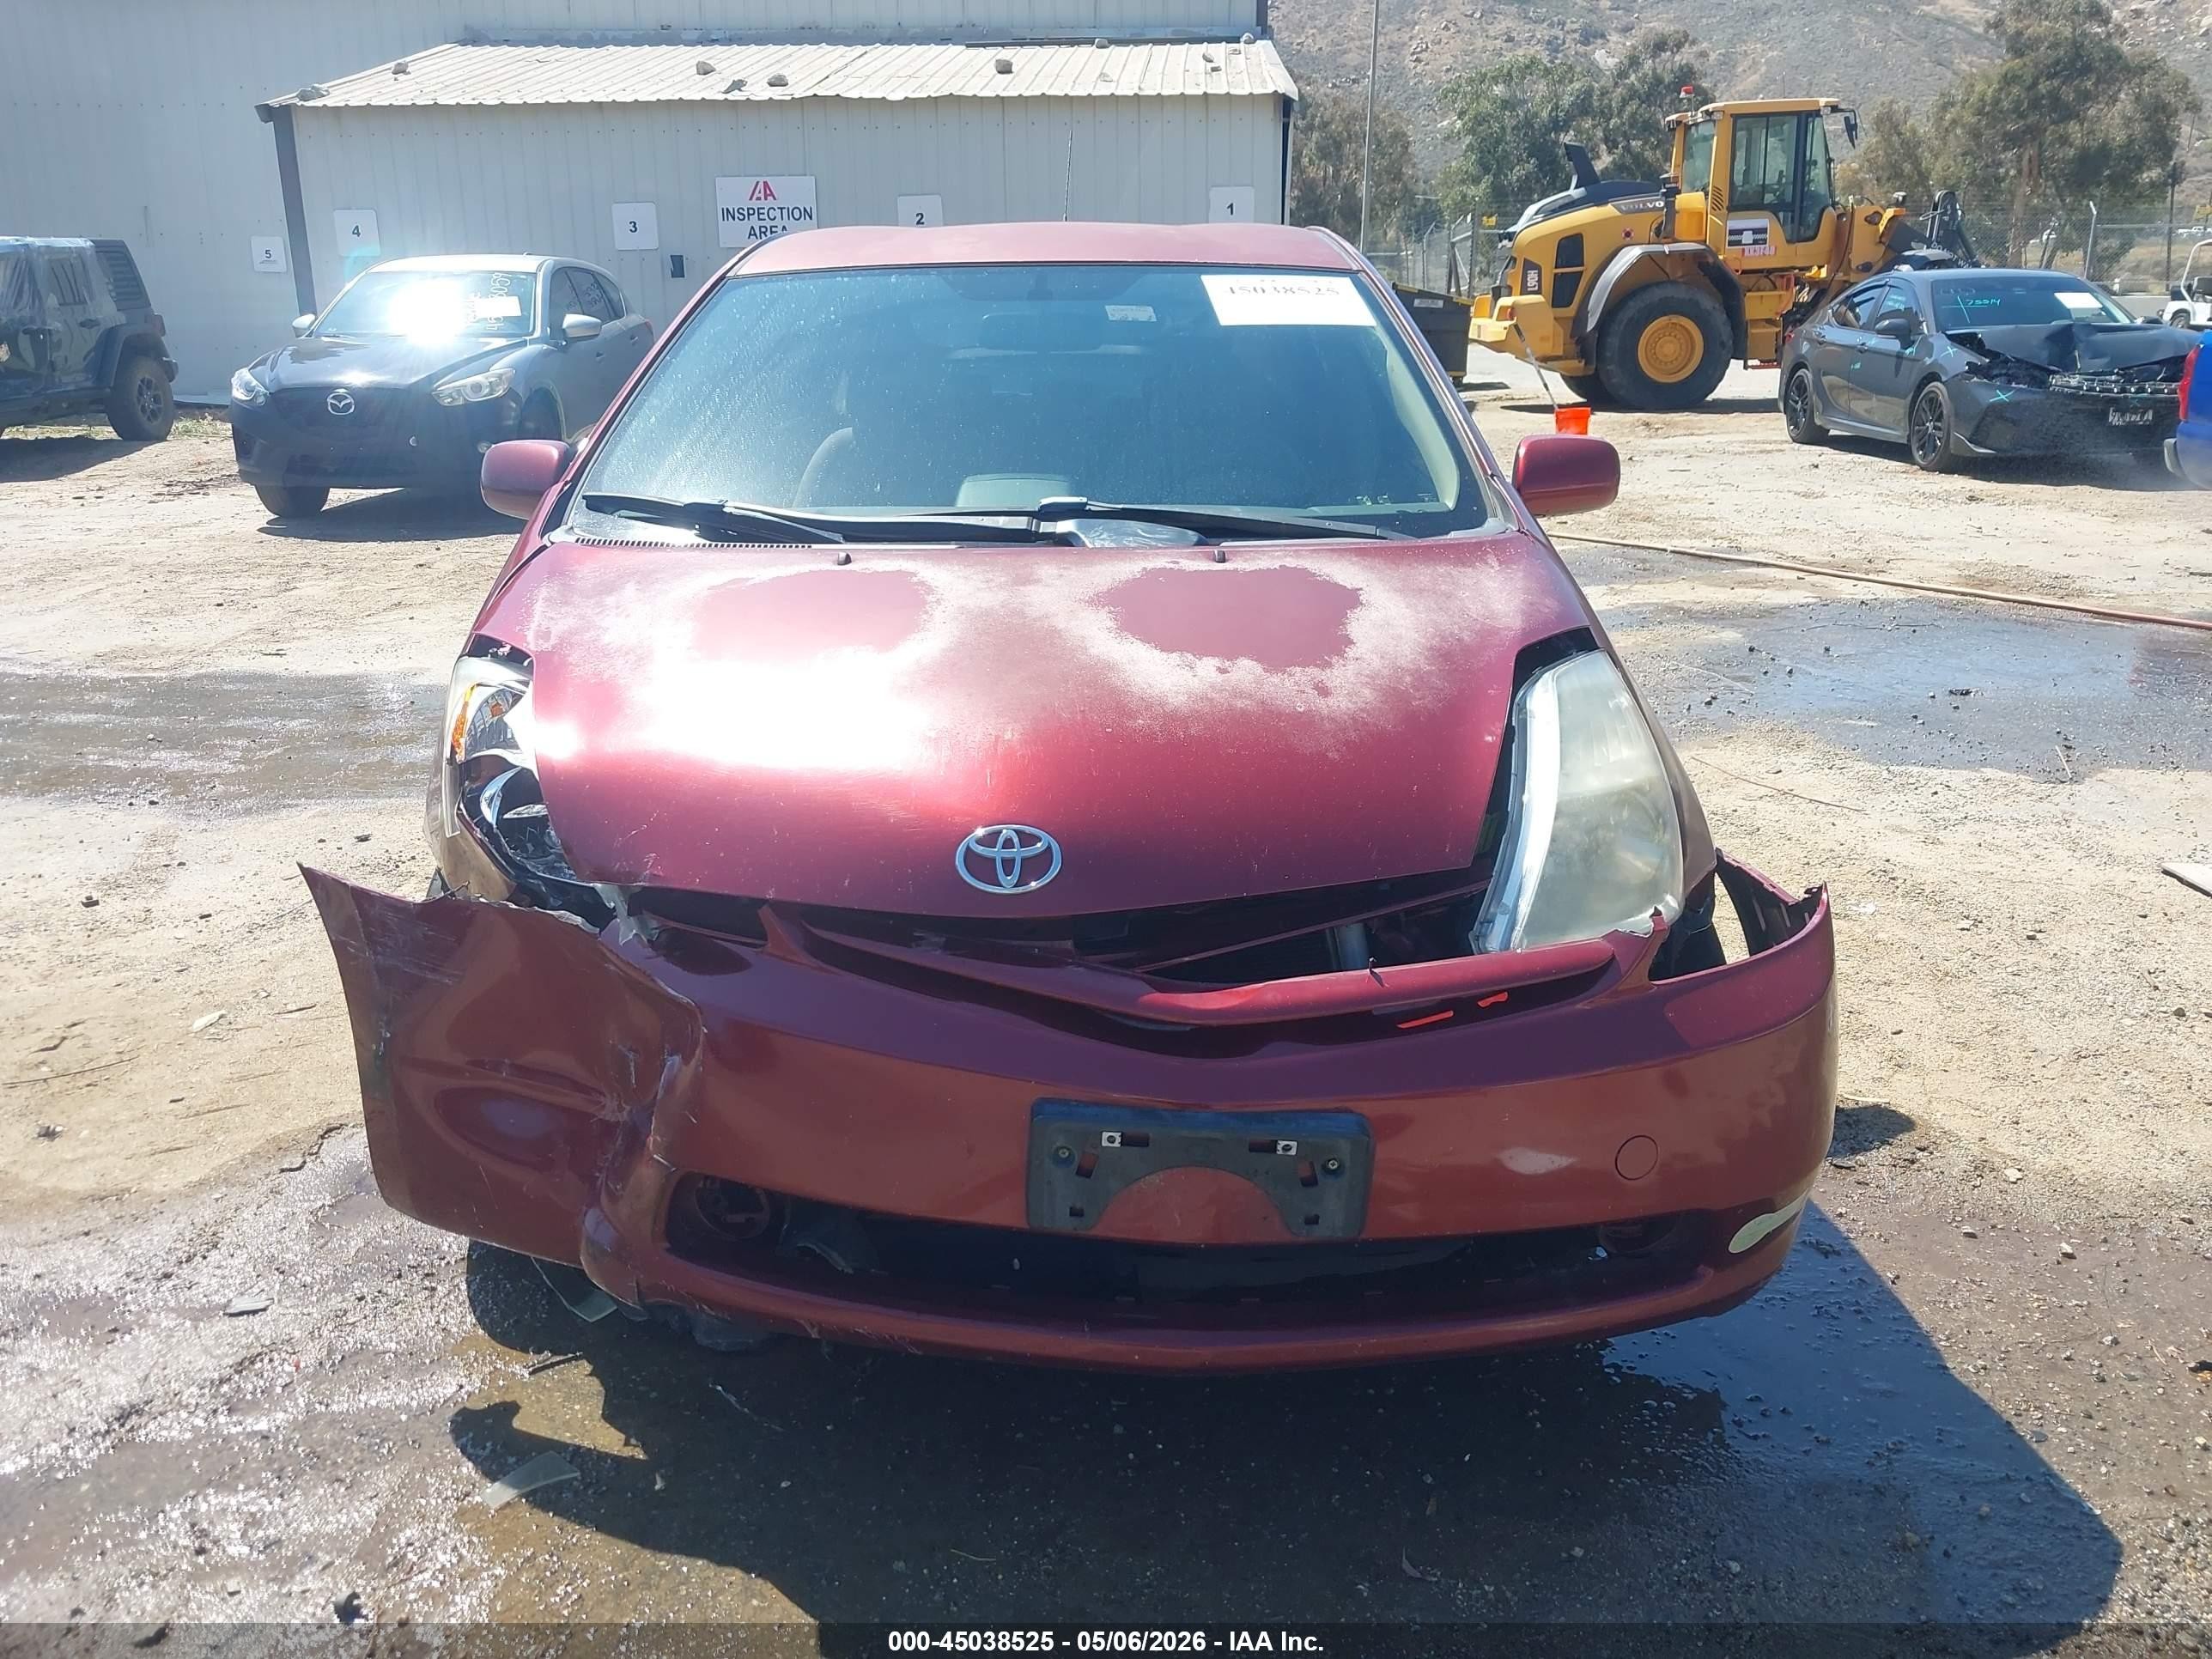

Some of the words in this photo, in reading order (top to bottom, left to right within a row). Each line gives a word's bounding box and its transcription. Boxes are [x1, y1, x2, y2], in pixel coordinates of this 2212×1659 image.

[1226, 203, 1234, 216] 1
[1620, 200, 1665, 211] VOLVO
[721, 206, 813, 222] INSPECTION
[915, 212, 925, 225] 2
[351, 225, 362, 238] 4
[629, 221, 638, 233] 3
[264, 249, 272, 259] 5
[1527, 270, 1539, 291] L90H
